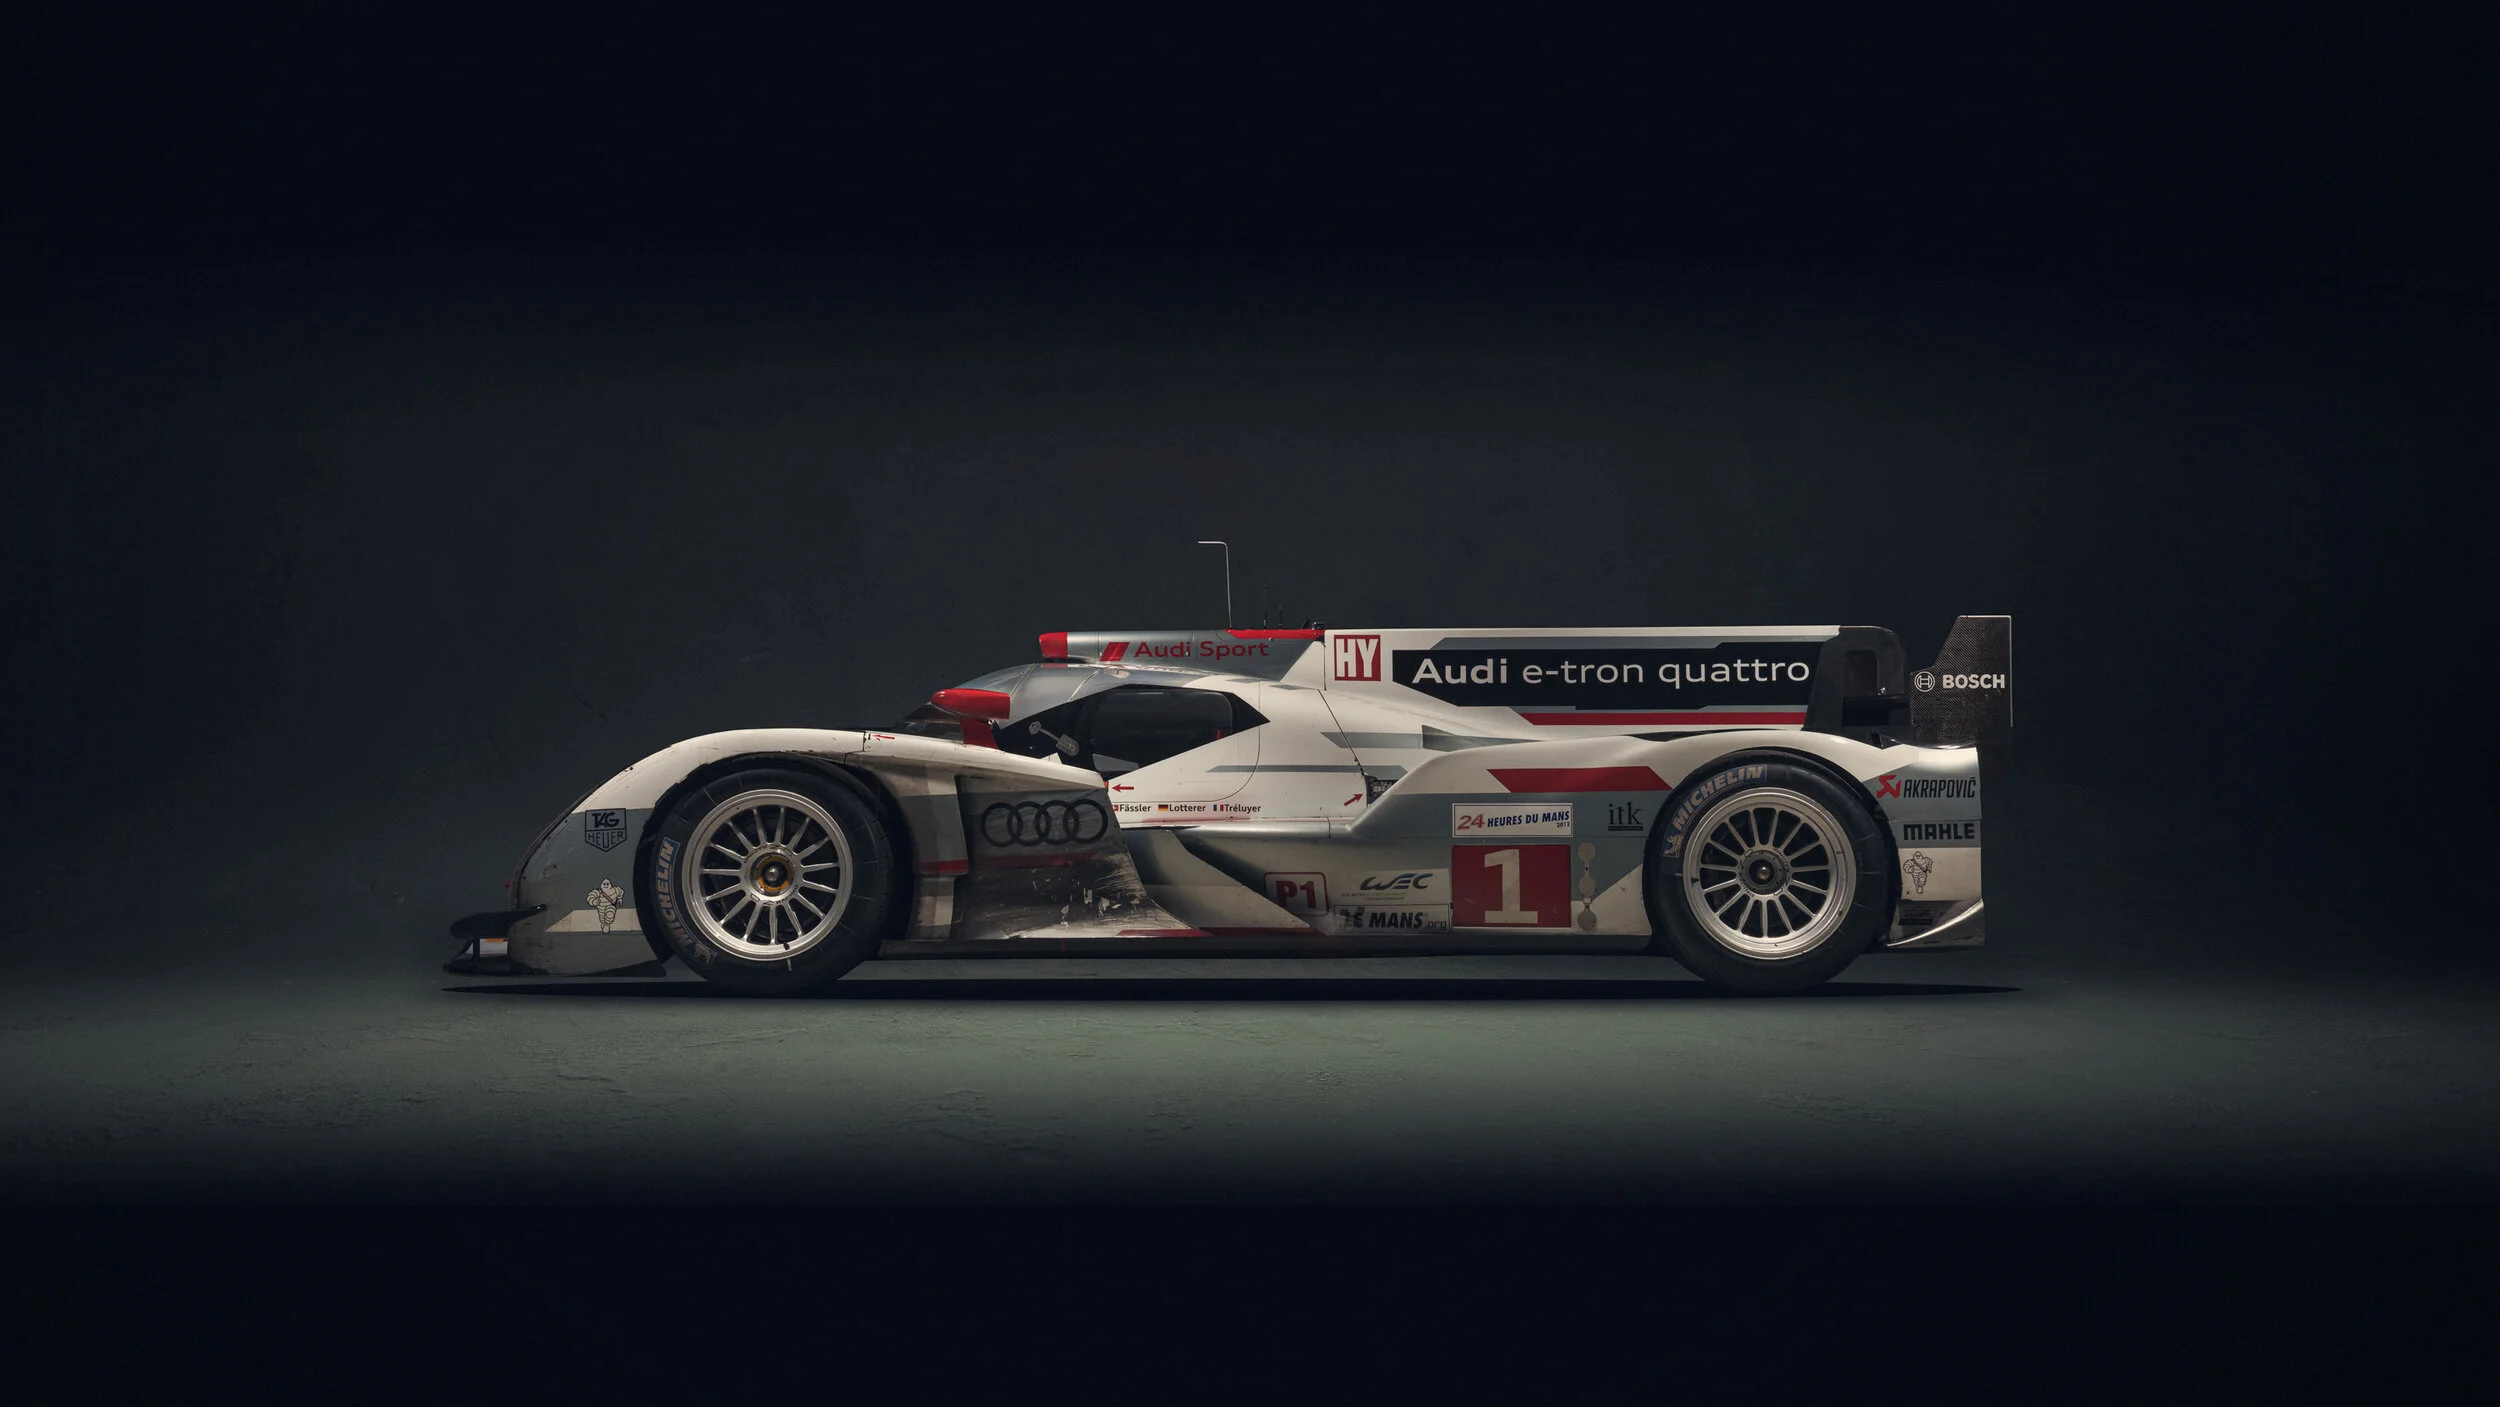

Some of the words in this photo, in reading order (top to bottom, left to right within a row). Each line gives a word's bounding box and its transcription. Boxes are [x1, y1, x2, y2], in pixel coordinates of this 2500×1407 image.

[1134, 641, 1190, 658] Audi
[1200, 641, 1269, 660] Sport
[1336, 638, 1379, 678] HY
[1412, 658, 1507, 684] Audi
[1522, 660, 1644, 684] e-tron
[1658, 658, 1810, 690] quattro
[1942, 674, 2006, 689] BOSCH
[1672, 766, 1764, 831] MICHELIN
[1119, 804, 1151, 812] Fässler
[1169, 804, 1206, 812] Lotterer
[1224, 804, 1261, 814] Tréluyer
[1608, 801, 1642, 825] itk
[591, 811, 620, 829] TAG
[1457, 814, 1486, 831] 24
[1487, 815, 1523, 828] HEURES
[1525, 813, 1539, 824] DU
[1542, 811, 1570, 823] MANS
[587, 830, 625, 848] HEUER
[1903, 823, 1975, 841] MAHLE
[1360, 873, 1434, 891] WEC
[1484, 848, 1539, 924] 1
[1275, 880, 1318, 909] P1
[1369, 912, 1424, 929] MANS
